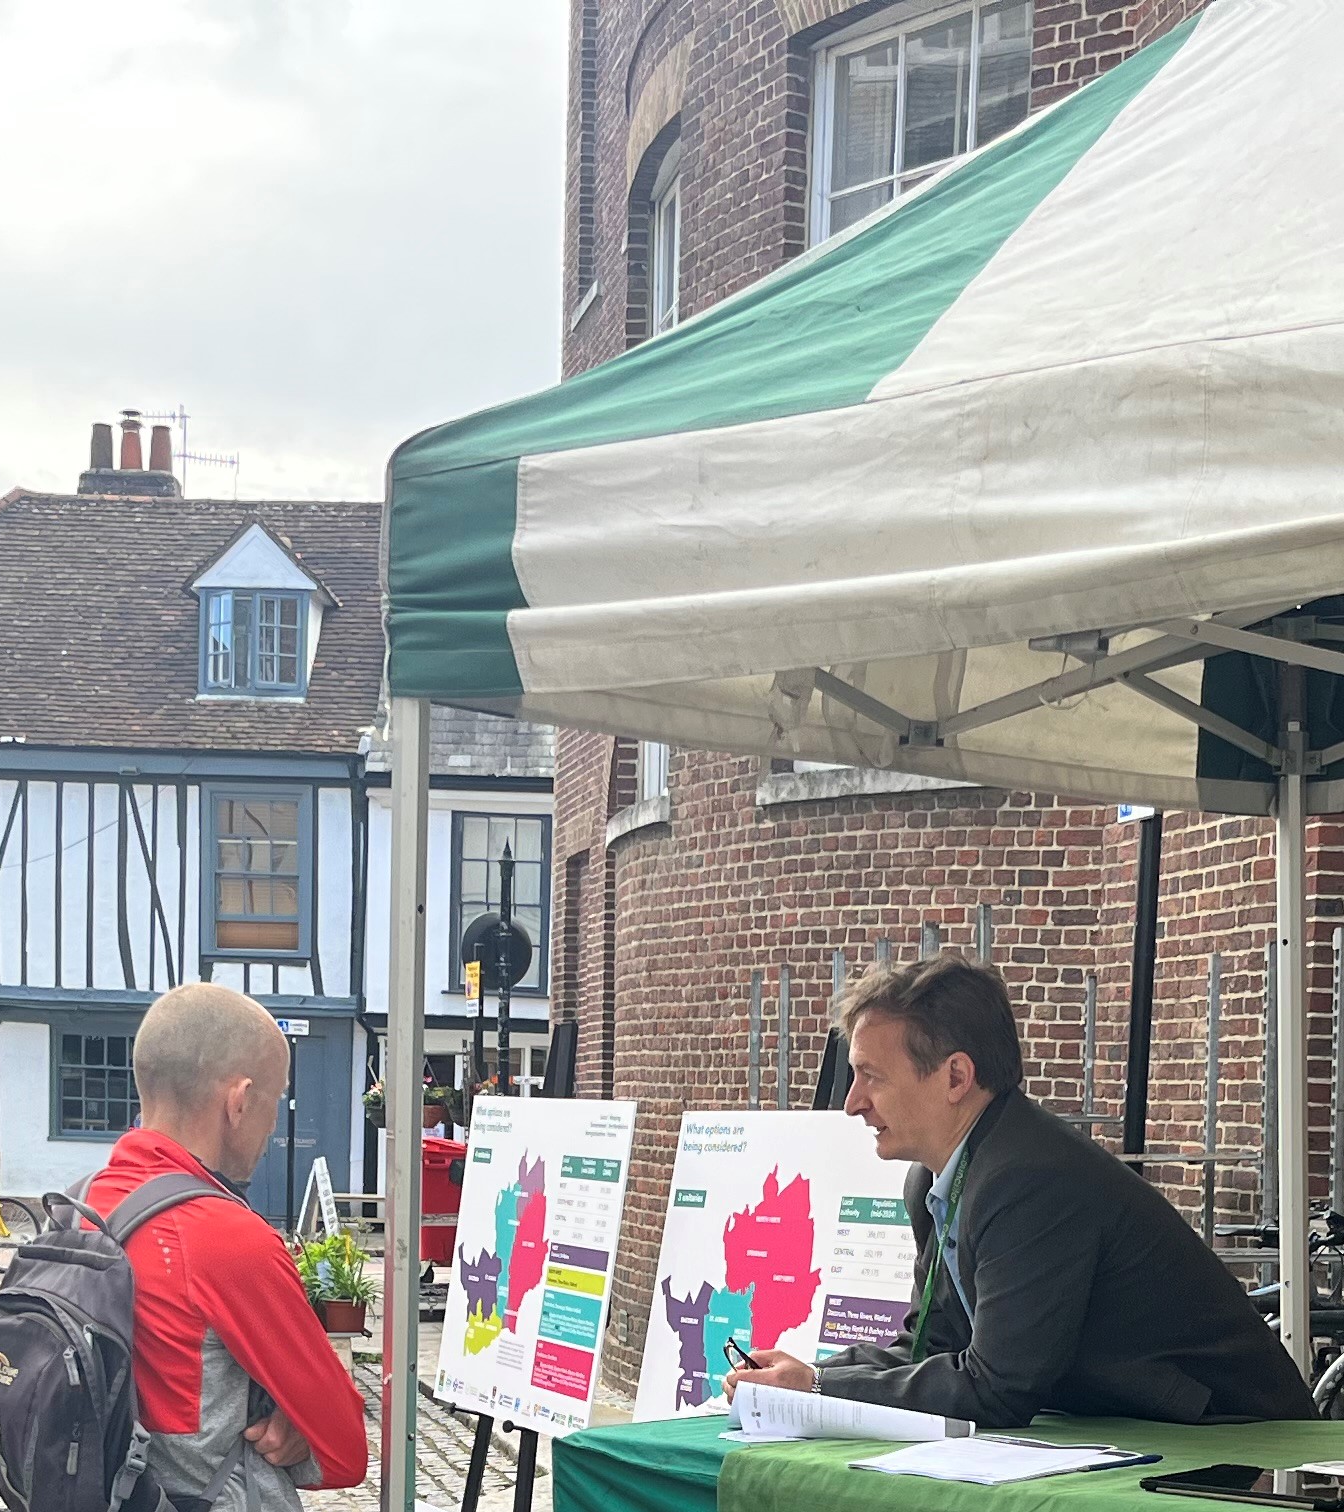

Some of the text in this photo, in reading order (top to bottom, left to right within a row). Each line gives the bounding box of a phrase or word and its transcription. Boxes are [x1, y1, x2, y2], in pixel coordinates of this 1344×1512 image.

[686, 1123, 745, 1138] What options are
[683, 1140, 748, 1155] being considered?
